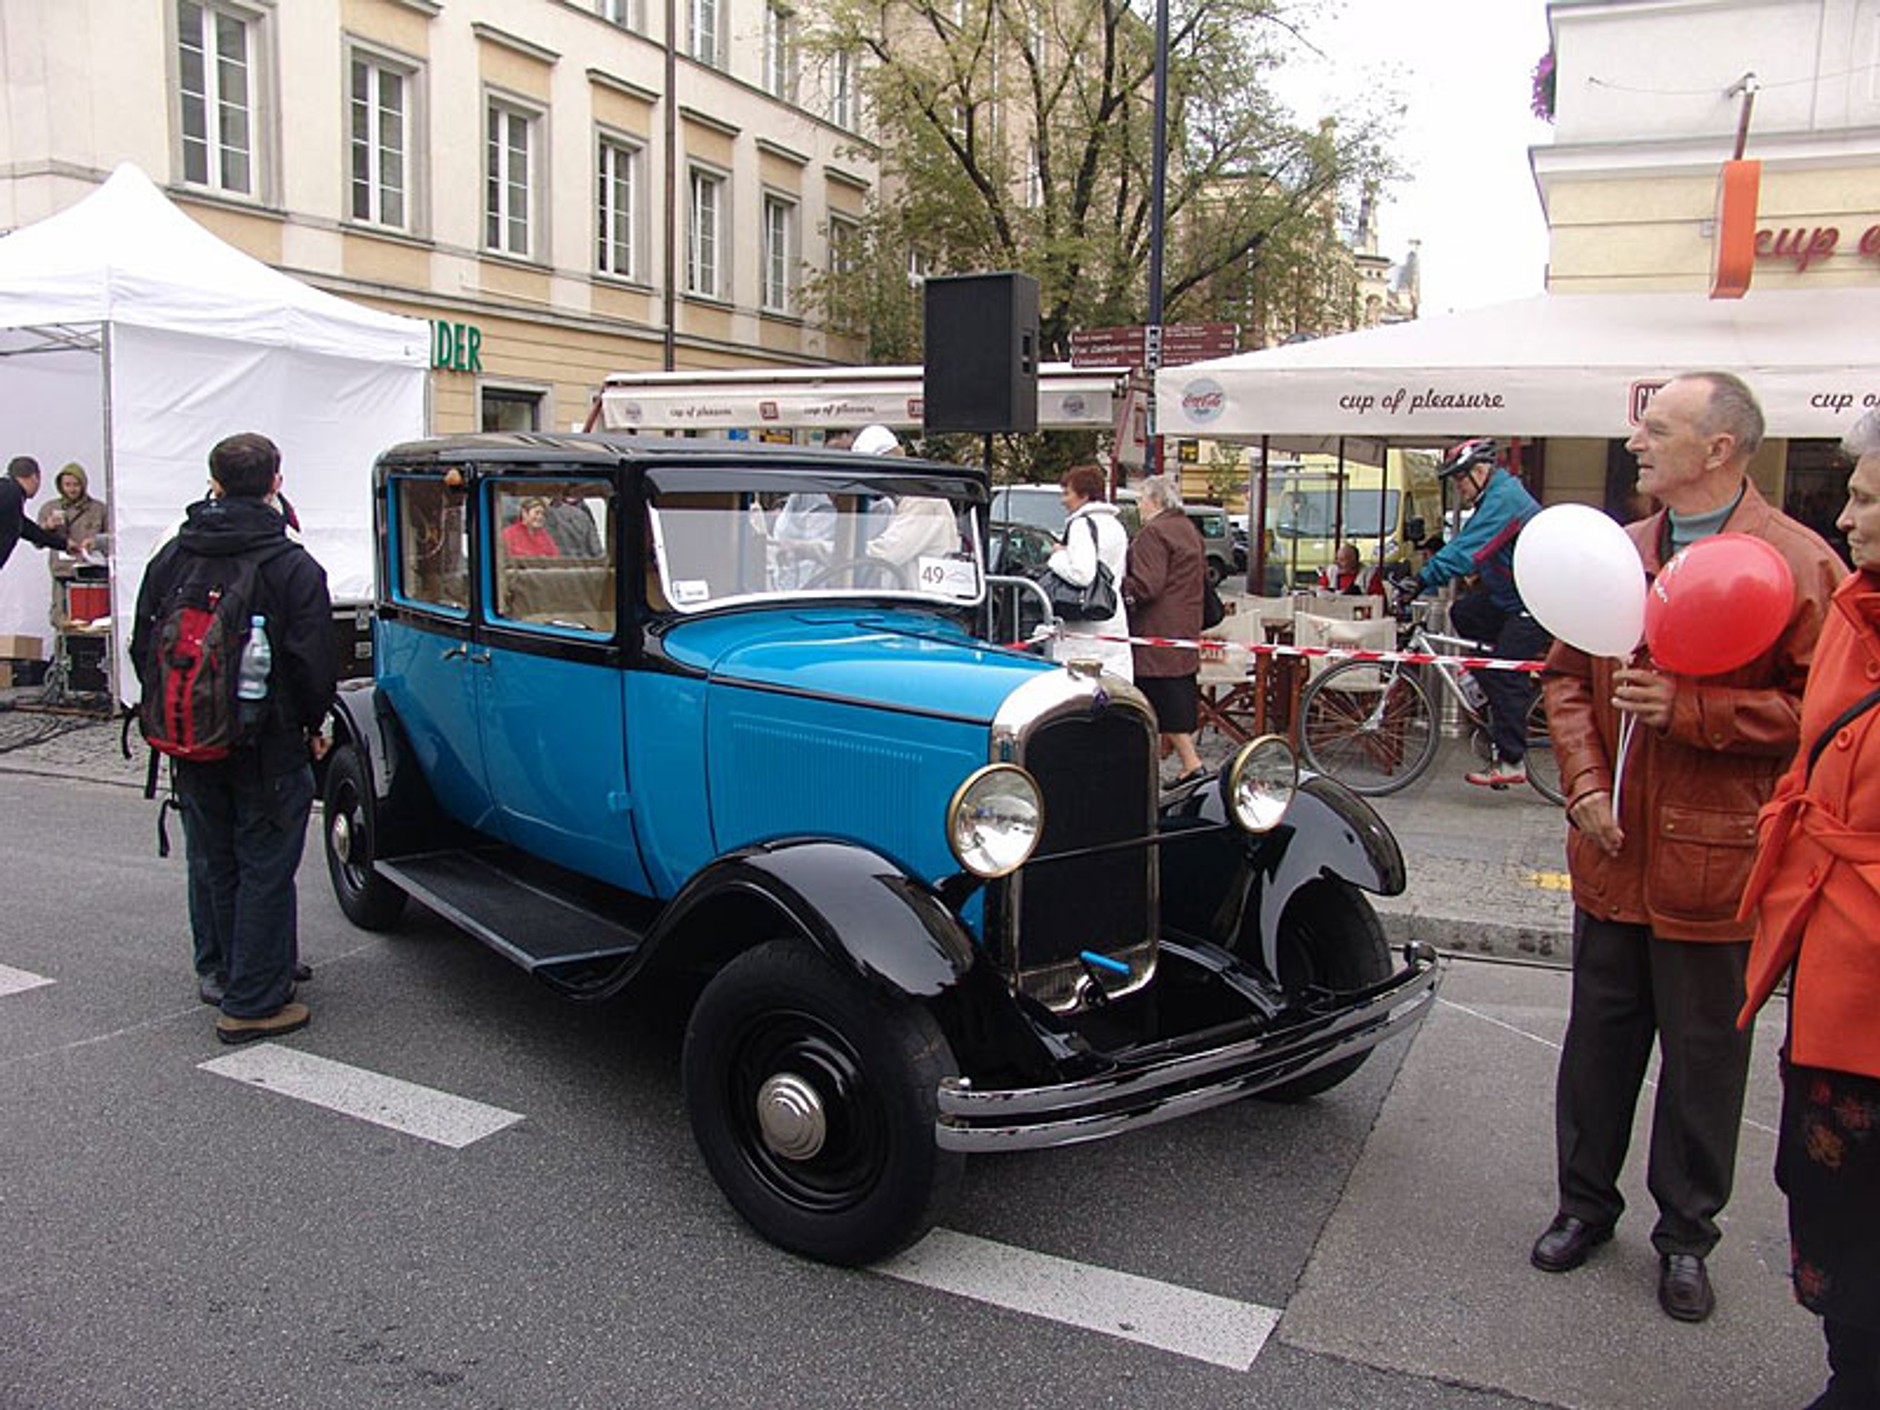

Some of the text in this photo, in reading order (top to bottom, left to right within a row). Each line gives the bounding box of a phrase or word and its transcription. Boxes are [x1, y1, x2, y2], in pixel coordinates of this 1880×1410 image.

[1755, 226, 1840, 273] cup
[1339, 388, 1505, 414] cup of pleasure
[1811, 394, 1853, 414] cup
[921, 566, 944, 584] 49
